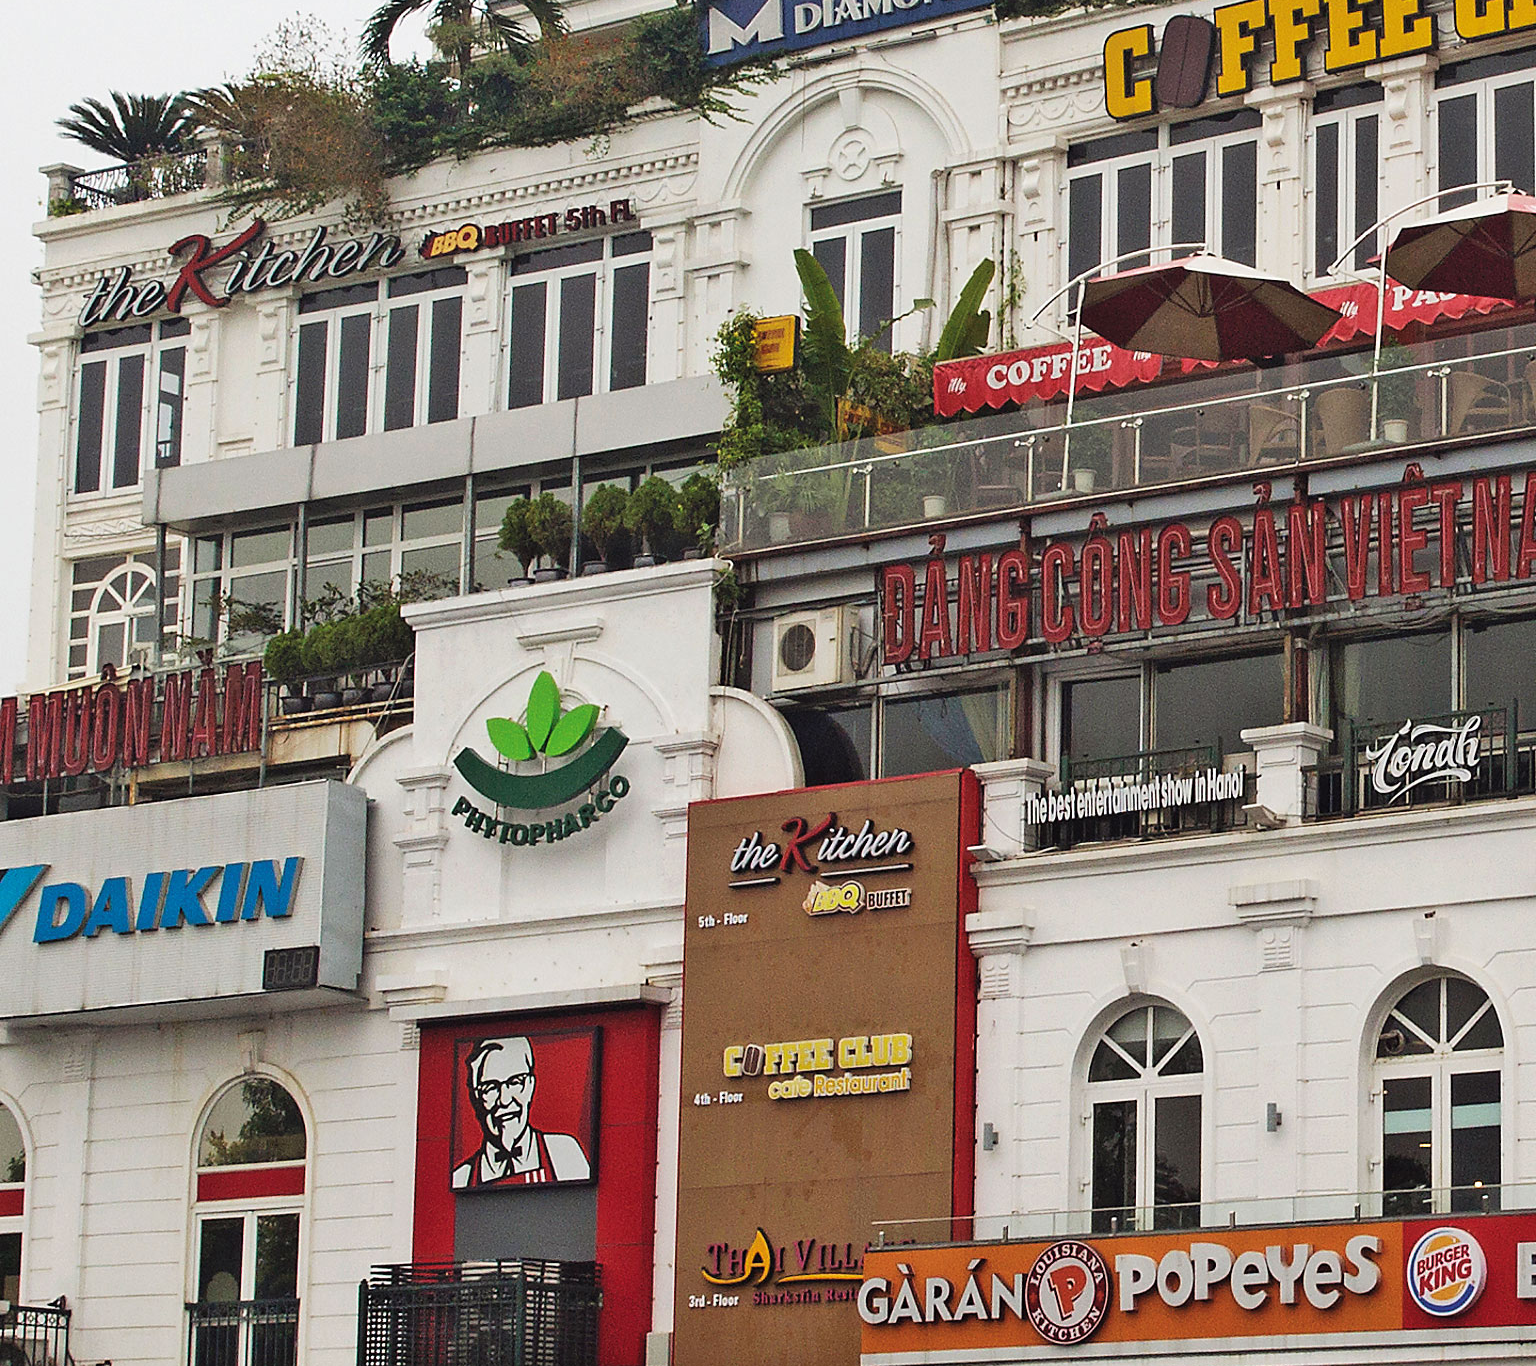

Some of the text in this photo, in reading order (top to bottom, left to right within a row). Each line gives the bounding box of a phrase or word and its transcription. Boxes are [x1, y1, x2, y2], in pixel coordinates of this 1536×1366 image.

[78, 198, 636, 328] the Kitchen BBQ BUFFET 5th FL
[985, 343, 1113, 391] COFFEE
[449, 771, 632, 848] PHYTOPHARCO
[1025, 763, 1245, 826] The best entertainment show in Hanoi
[729, 811, 915, 875] the Kitchen
[32, 855, 305, 945] DAIKIN
[810, 880, 912, 914] BBQ BUFFET
[722, 912, 749, 927] Floor
[837, 1032, 914, 1070] CLUB
[718, 1091, 744, 1105] Floor
[813, 1067, 912, 1097] Restaurant
[1028, 1241, 1107, 1290] LOUISIANA
[1416, 1242, 1471, 1278] BURGER
[1417, 1257, 1474, 1298] KING
[712, 1293, 740, 1308] Floor
[1033, 1308, 1102, 1343] KITCHEN
